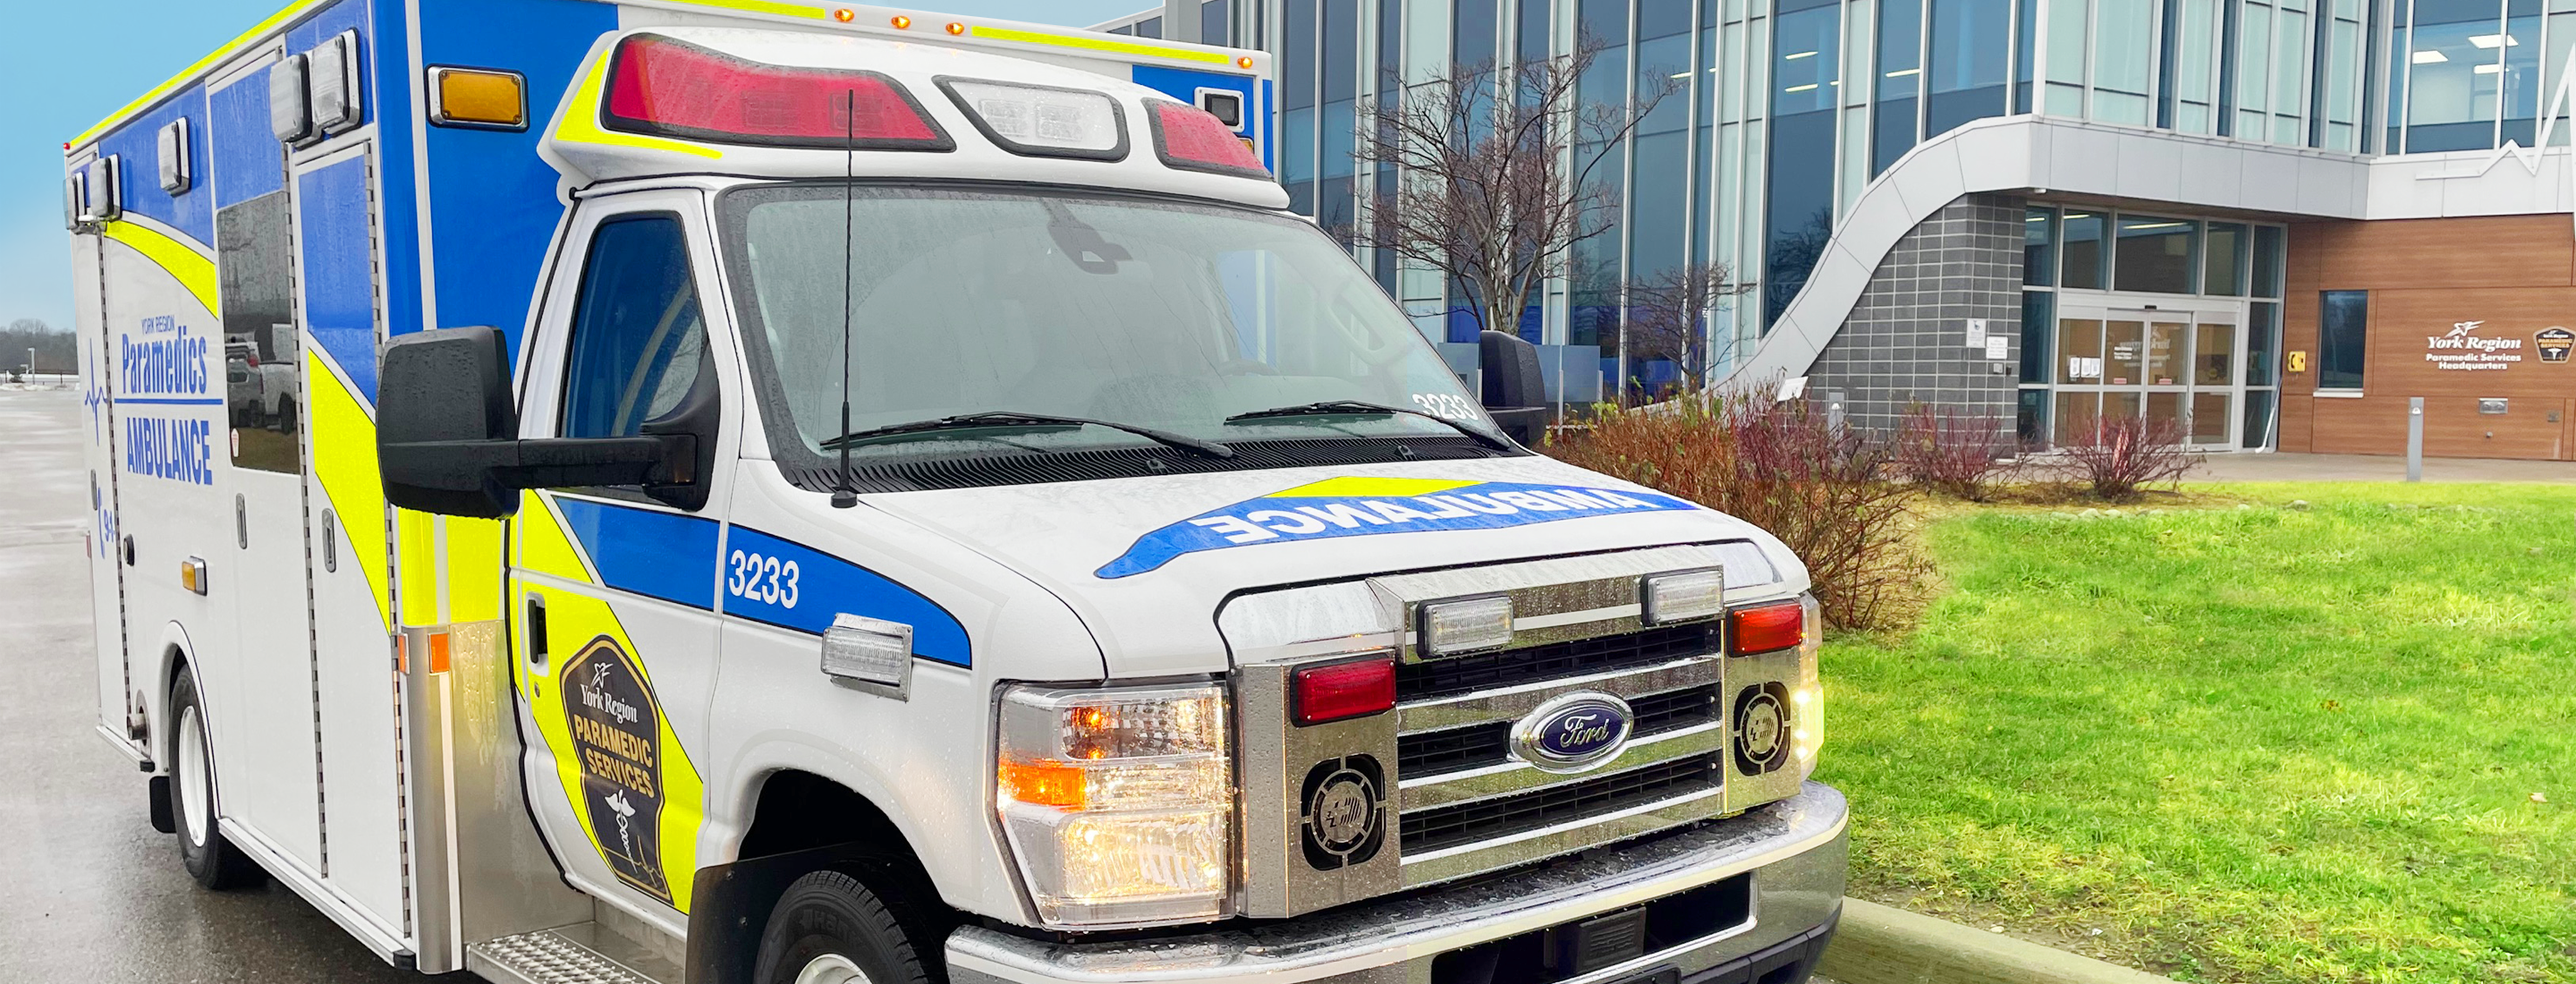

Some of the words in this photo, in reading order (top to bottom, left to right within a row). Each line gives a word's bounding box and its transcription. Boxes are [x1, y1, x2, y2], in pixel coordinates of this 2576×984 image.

[140, 318, 155, 334] YORK
[156, 315, 175, 332] REGION
[2428, 335, 2463, 349] York
[2465, 336, 2521, 352] Region
[122, 325, 208, 394] Paramedics
[2426, 353, 2479, 361] Paramedic
[2480, 353, 2521, 361] Services
[2438, 361, 2508, 370] Headquarters
[1411, 393, 1479, 420] 3233
[126, 416, 213, 486] AMBULANCE
[728, 549, 801, 609] 3233
[580, 683, 604, 710] York
[604, 692, 639, 725] Region
[573, 714, 653, 768] PARAMEDIC
[1559, 713, 1610, 748] Ford
[585, 747, 655, 798] SERVICES
